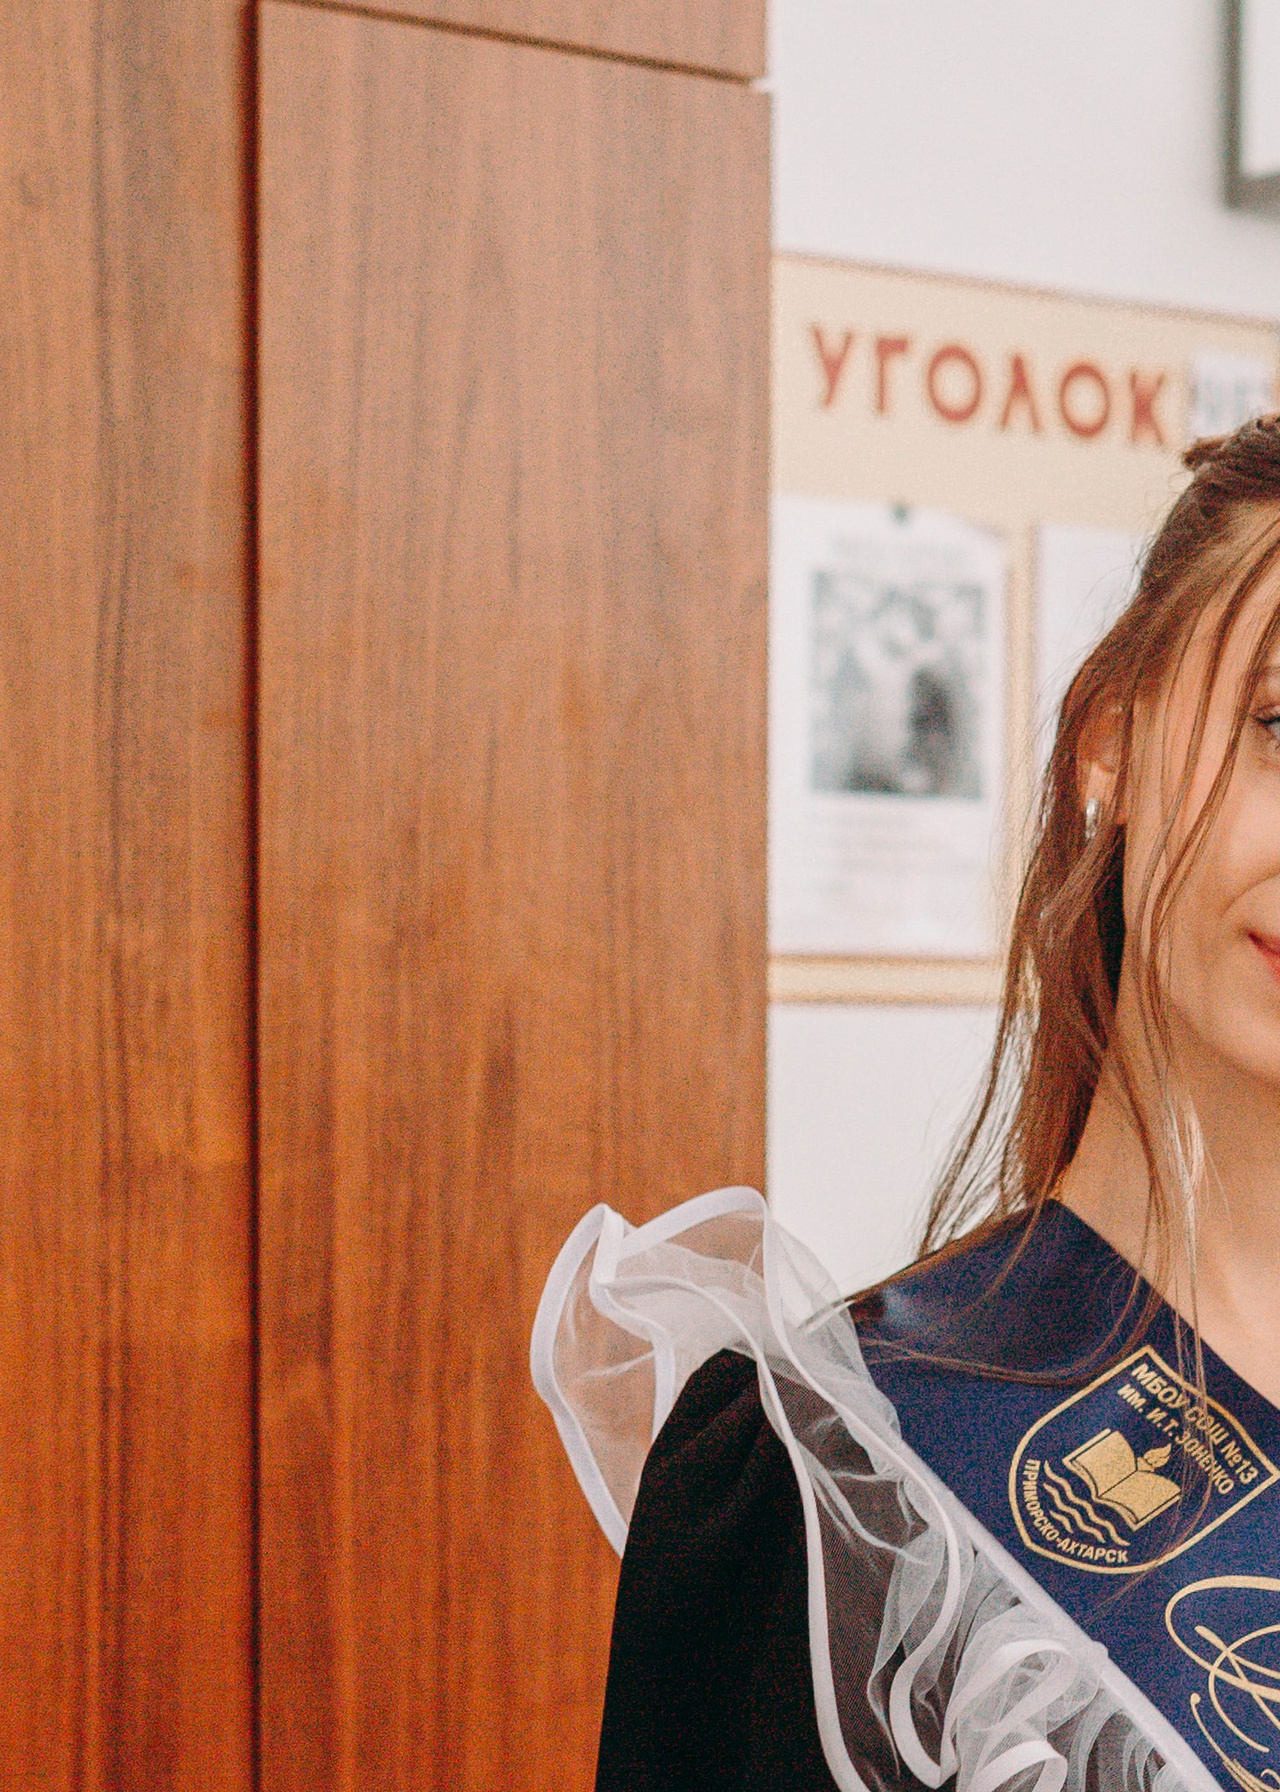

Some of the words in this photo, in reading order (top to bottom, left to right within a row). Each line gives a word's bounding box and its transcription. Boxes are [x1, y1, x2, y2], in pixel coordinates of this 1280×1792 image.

[806, 322, 1166, 447] УГОЛОК
[1117, 1383, 1146, 1414] ИМ.
[1131, 1363, 1190, 1409] МБОУ
[1184, 1405, 1230, 1445] СОШ
[1221, 1441, 1258, 1484] №13
[1022, 1459, 1128, 1563] ПРИМОРСКО-АХТАРСК
